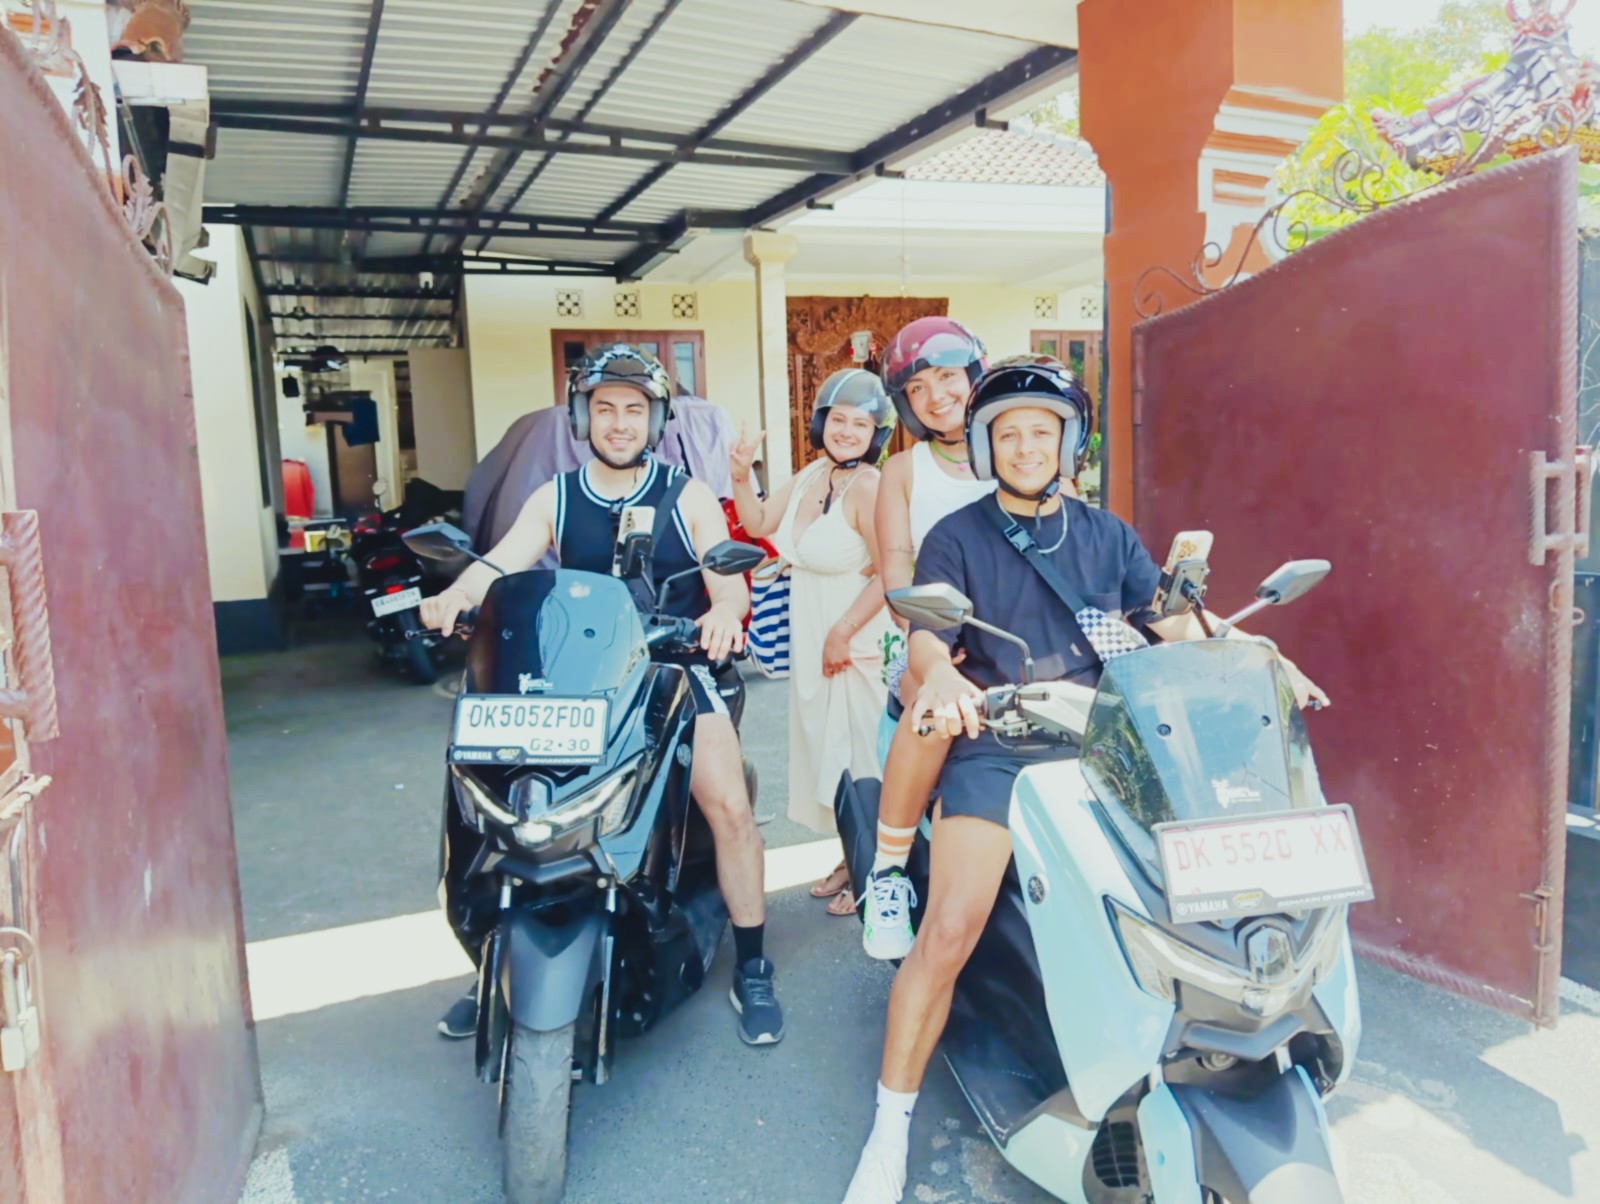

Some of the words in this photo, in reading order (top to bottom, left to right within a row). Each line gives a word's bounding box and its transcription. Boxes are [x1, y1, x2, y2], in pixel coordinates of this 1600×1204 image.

[1173, 837, 1212, 871] DK
[1310, 823, 1347, 855] XX
[1187, 899, 1229, 914] YAMAHA
